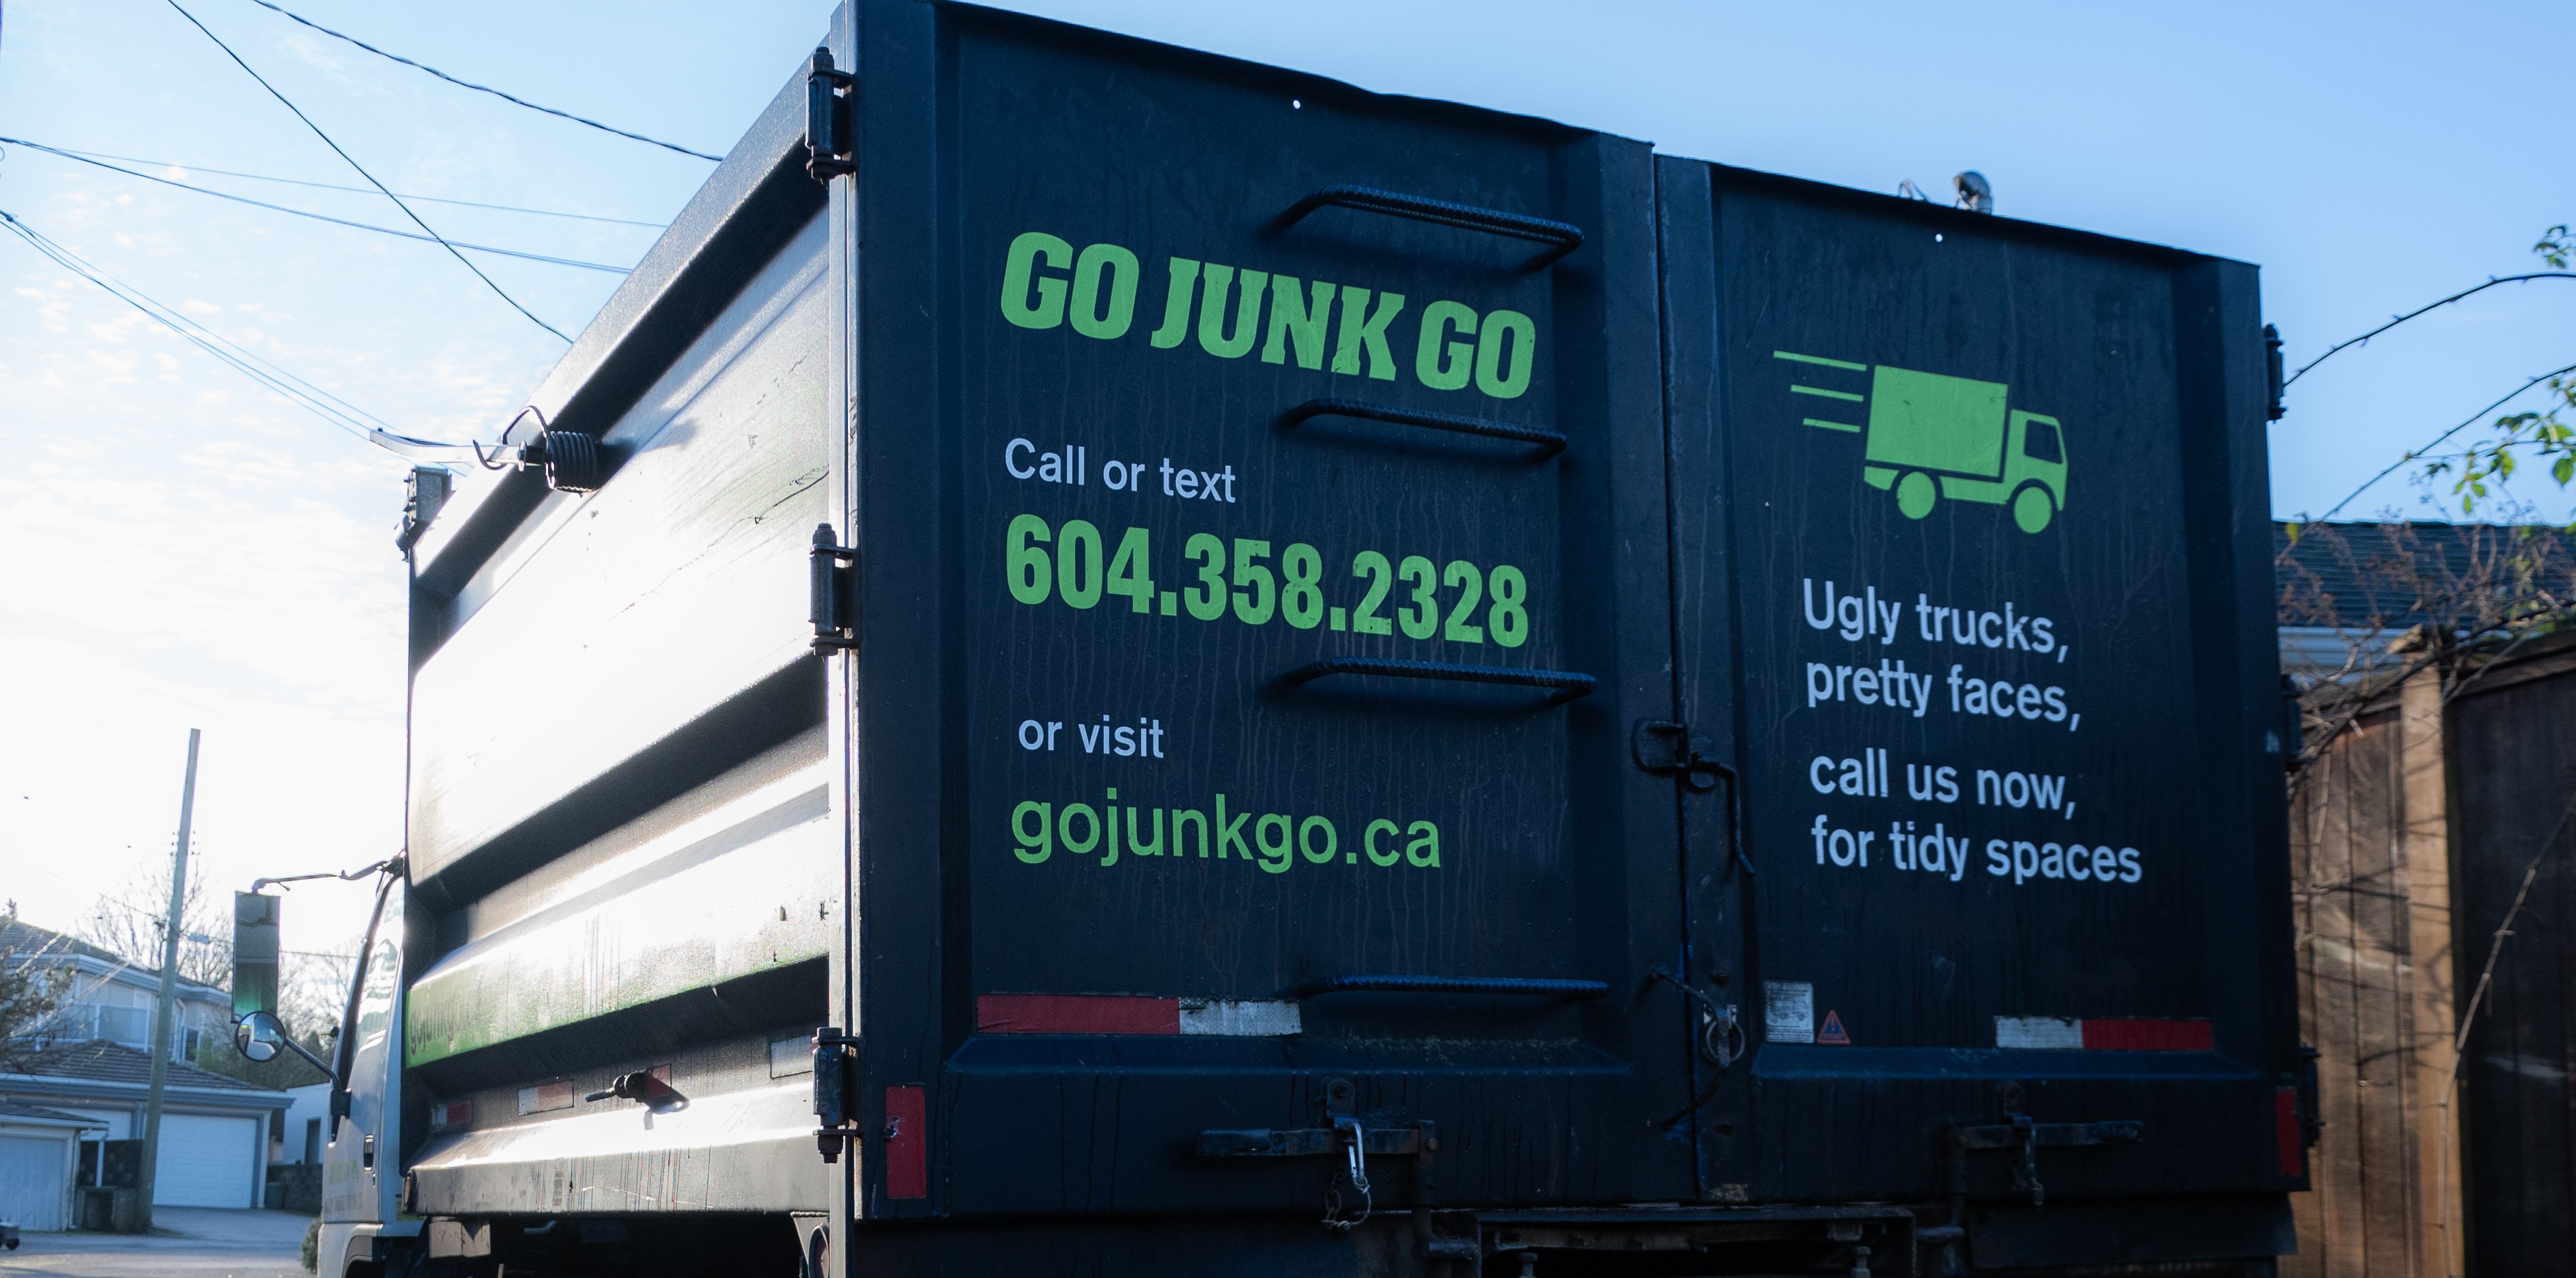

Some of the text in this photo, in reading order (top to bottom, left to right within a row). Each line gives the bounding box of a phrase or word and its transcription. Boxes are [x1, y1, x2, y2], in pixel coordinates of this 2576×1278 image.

[1001, 232, 1535, 399] GO JUNK GO
[1005, 438, 1236, 503] Call or text
[1006, 514, 1529, 648] 604.358.2328
[1803, 578, 2069, 663] Ugly trucks,
[1807, 658, 2081, 732] pretty faces,
[1019, 715, 1164, 758] or visit
[1810, 747, 2076, 820] call us now,
[1012, 787, 1441, 874] gojunkgo.ca
[1811, 815, 2142, 885] for tidy spaces
